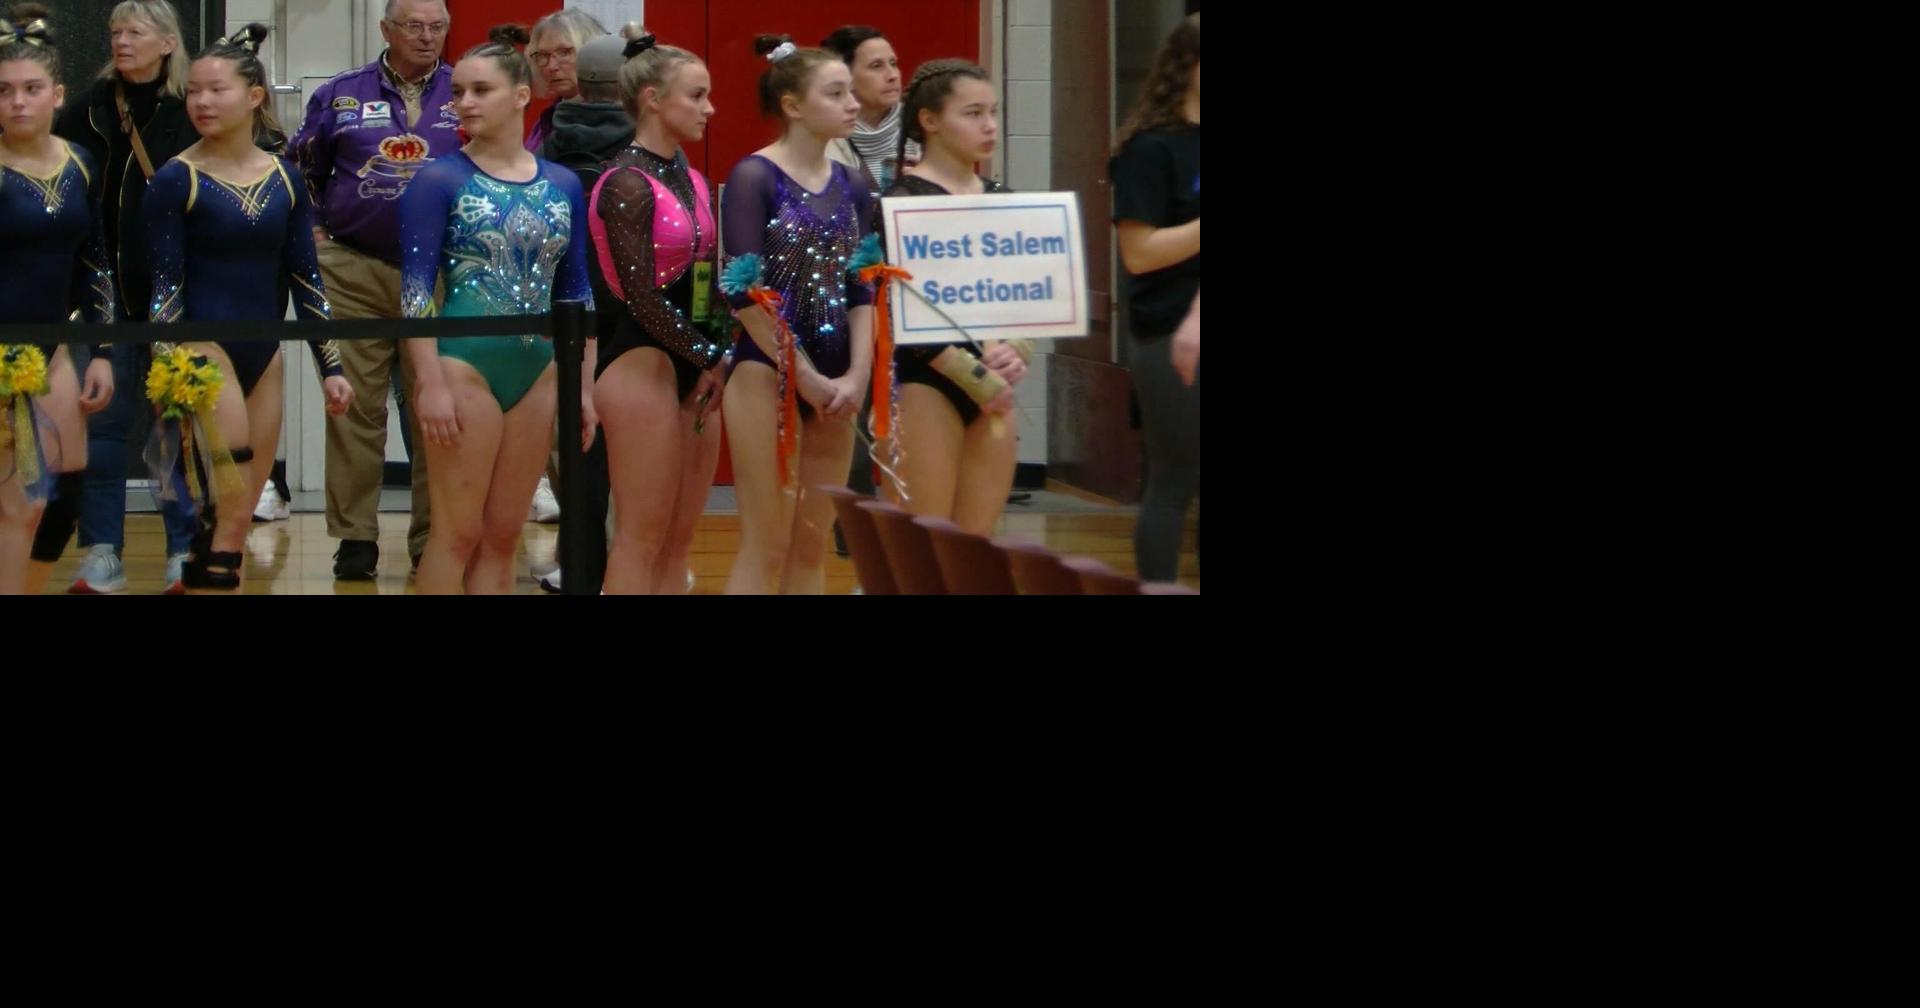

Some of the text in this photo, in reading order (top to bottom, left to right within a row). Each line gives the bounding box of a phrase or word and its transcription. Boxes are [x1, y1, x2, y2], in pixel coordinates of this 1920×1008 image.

[903, 230, 1066, 260] West Salem
[923, 276, 1053, 305] Sectional
